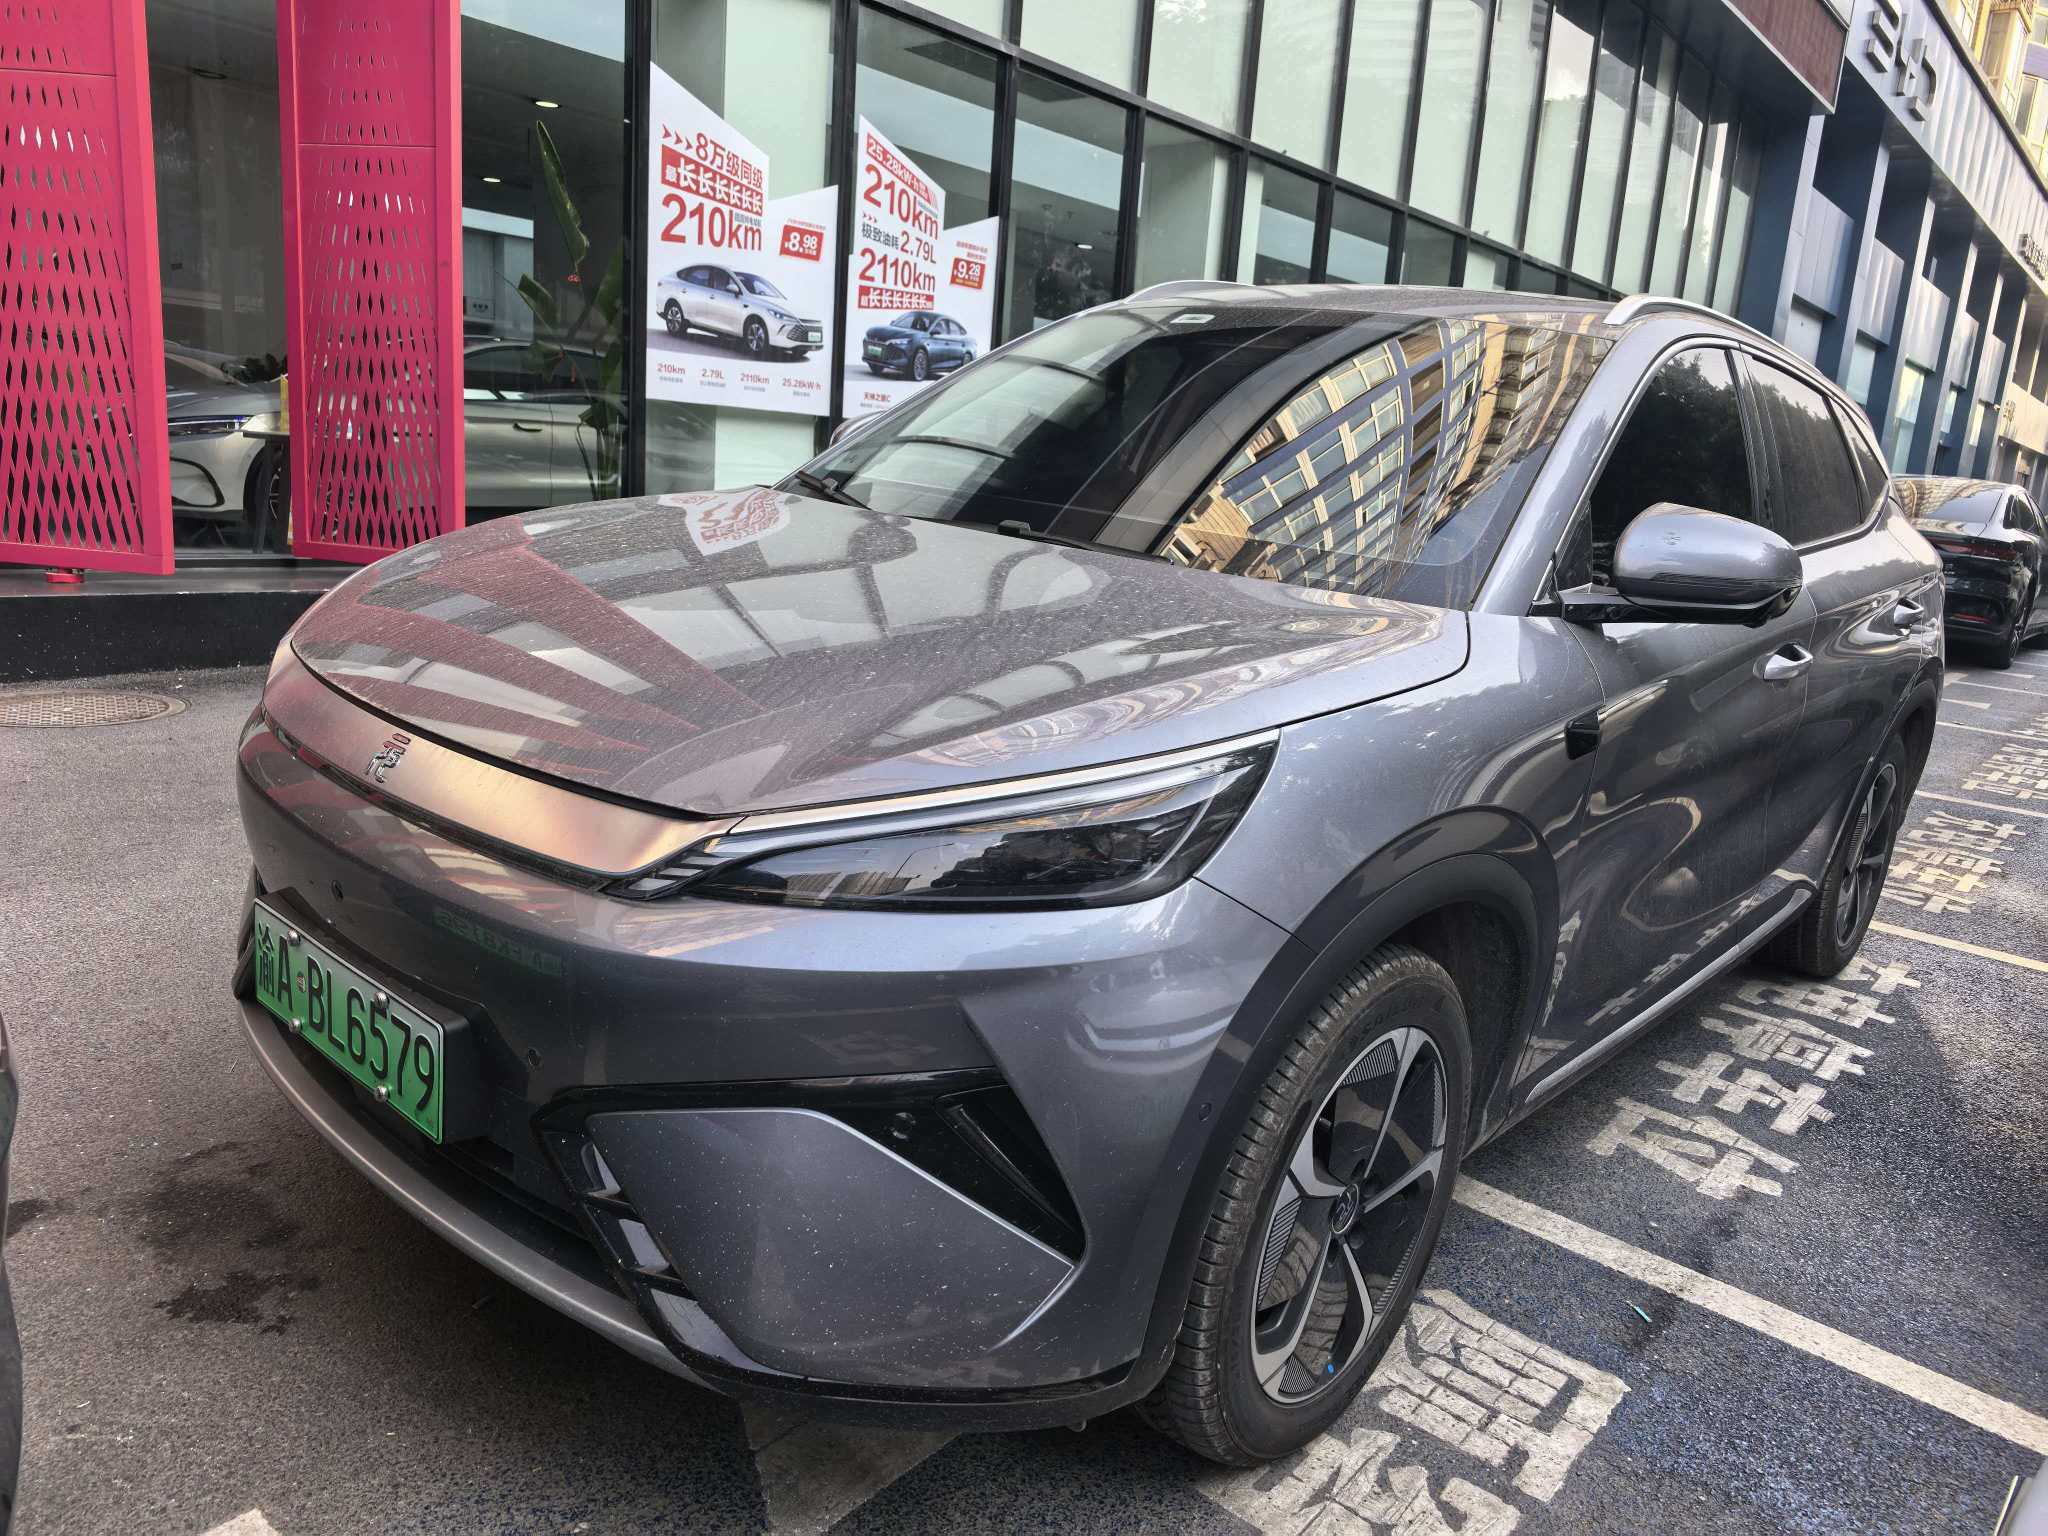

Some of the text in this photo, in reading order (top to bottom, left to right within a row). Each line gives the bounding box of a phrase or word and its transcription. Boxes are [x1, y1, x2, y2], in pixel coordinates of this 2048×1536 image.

[695, 132, 763, 191] 8万级同级
[863, 163, 939, 240] 210km
[661, 193, 762, 251] 210km
[901, 230, 936, 264] 2.79L
[858, 248, 936, 293] 2110km
[657, 363, 686, 375] 210km
[702, 368, 725, 380] 2.79L
[740, 373, 770, 385] 2110km
